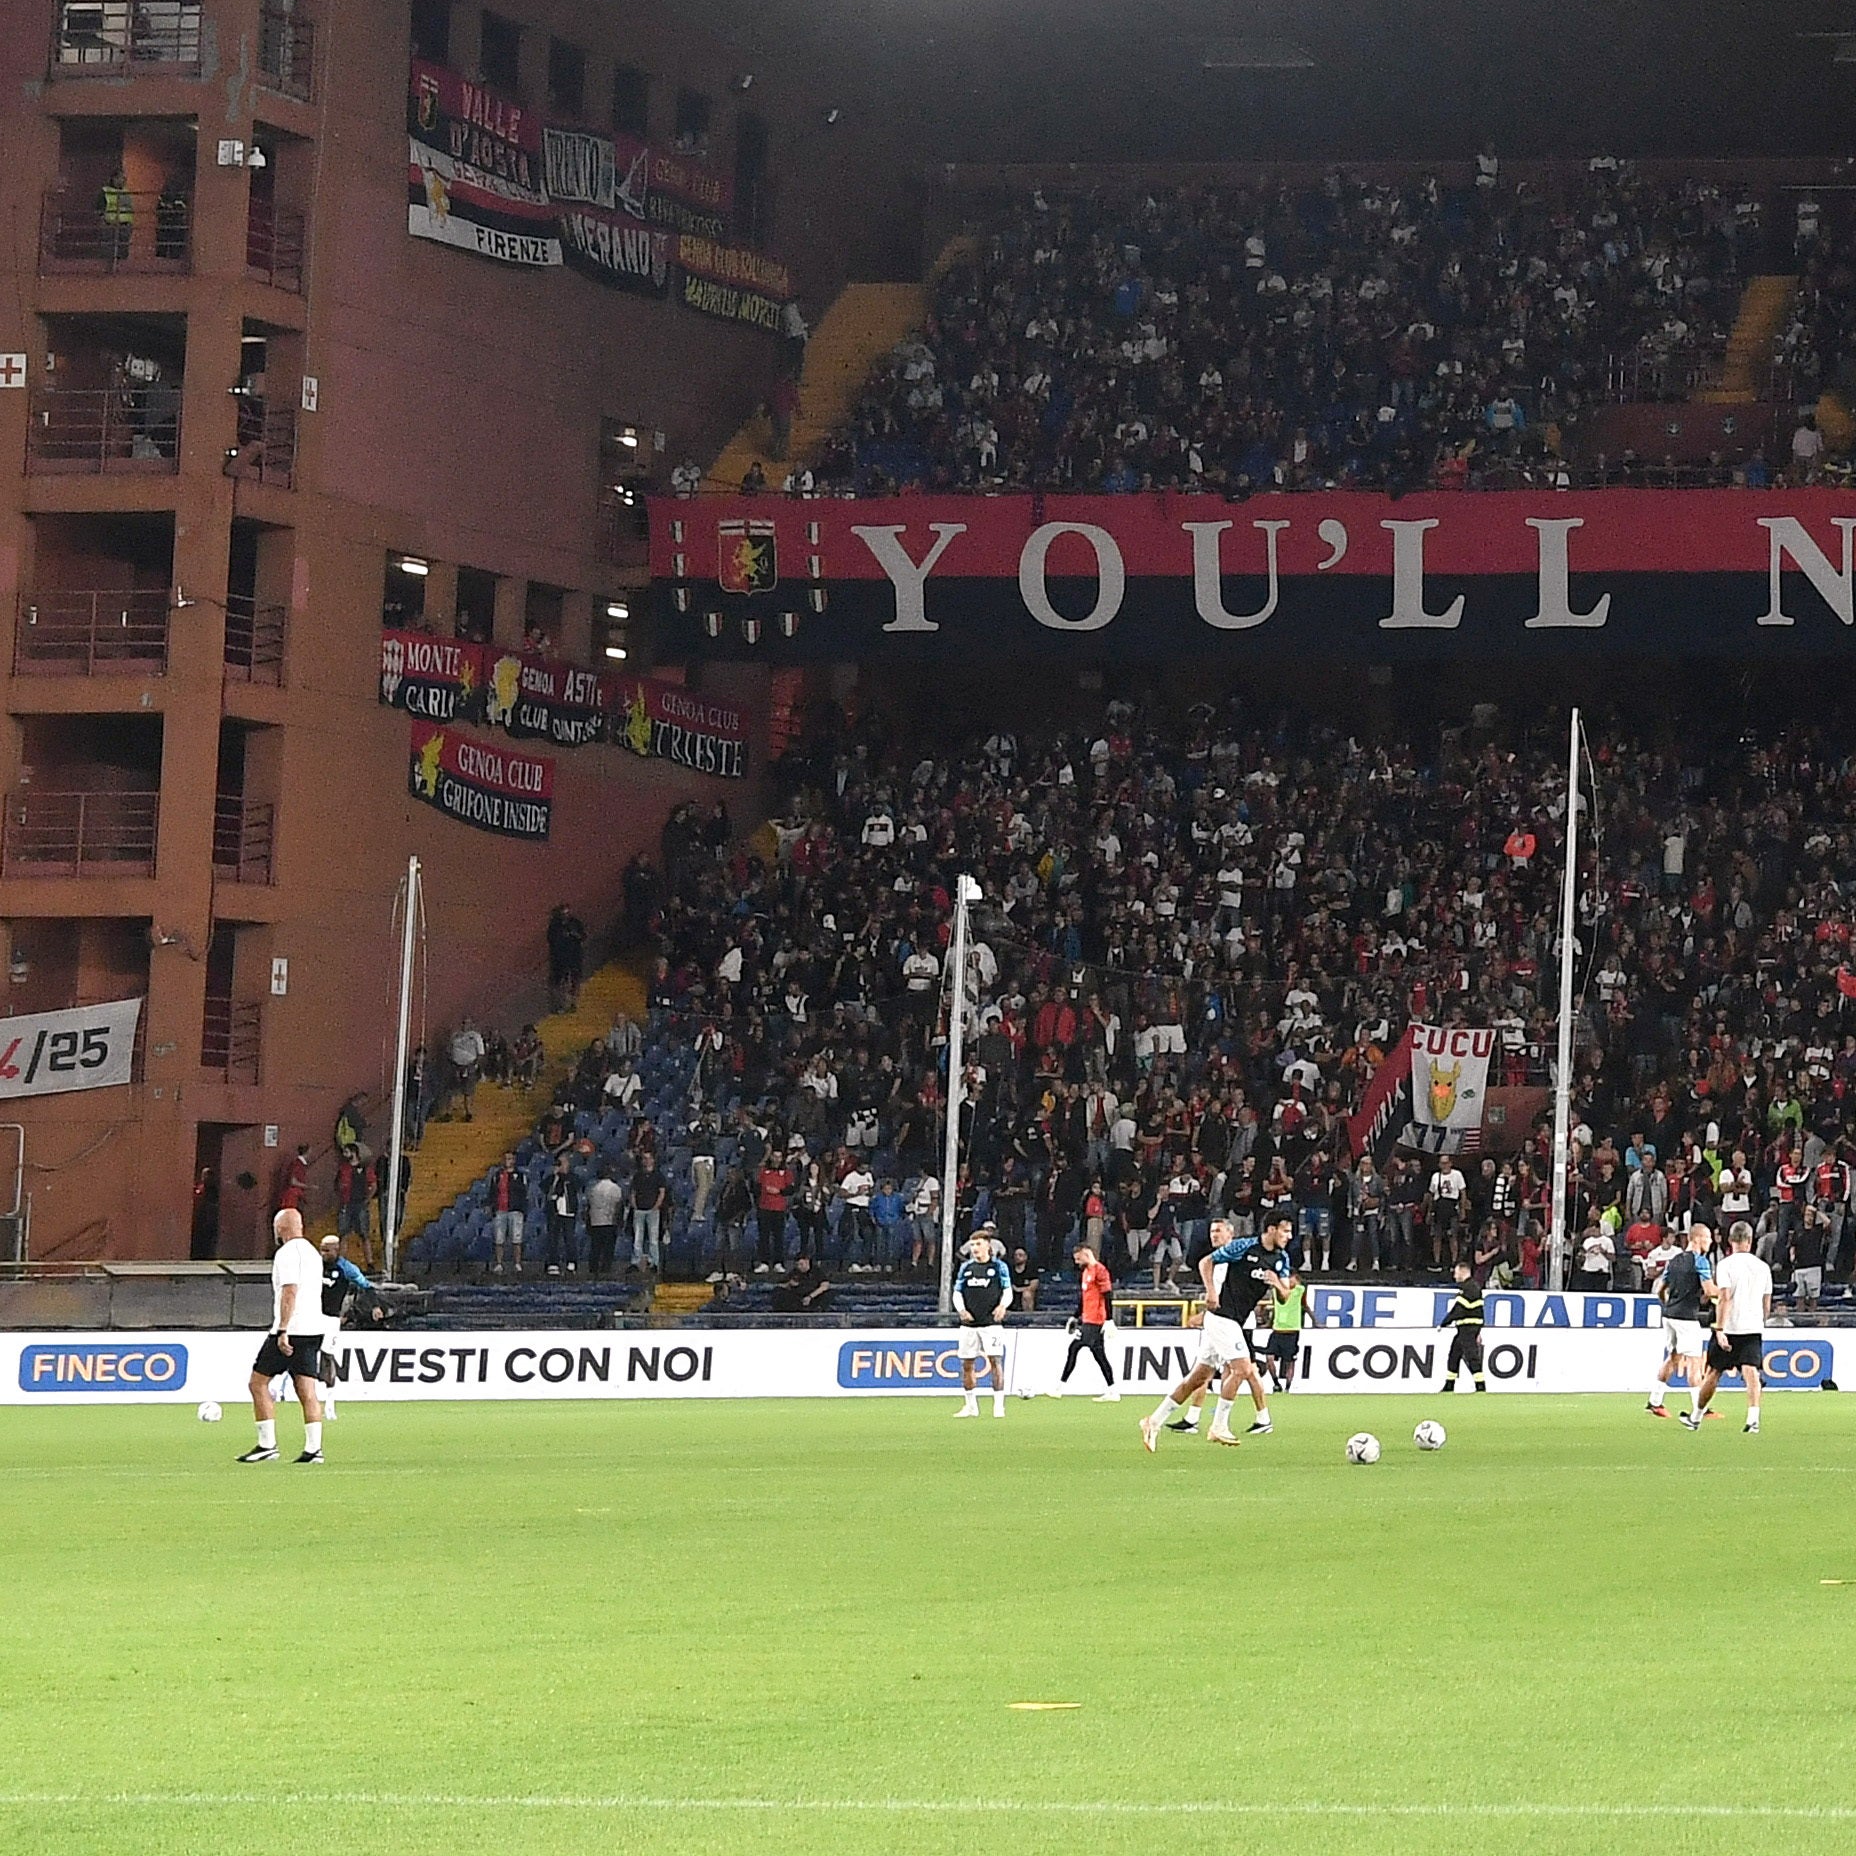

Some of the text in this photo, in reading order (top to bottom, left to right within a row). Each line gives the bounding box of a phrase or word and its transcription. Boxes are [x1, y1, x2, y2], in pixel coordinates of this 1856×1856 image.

[462, 81, 521, 144] VALLE
[475, 227, 550, 263] FIRENZE
[571, 213, 650, 277] MERANO
[851, 517, 1611, 633] YOU'LL
[407, 642, 461, 676] MONTE
[522, 666, 554, 697] GENOA
[520, 703, 549, 731] CLUB
[661, 694, 740, 731] GENOA CLUB
[655, 719, 742, 777] TRIESTE
[458, 744, 543, 792] GENOA CLUB
[443, 779, 548, 833] GRIFONE INSIDE
[1409, 1024, 1493, 1058] CUCU
[967, 1276, 991, 1289] ebay
[32, 1353, 176, 1382] FINECO
[322, 1346, 713, 1383] NVESTI CON NOI
[1122, 1345, 1312, 1381] INVI
[1328, 1344, 1434, 1379] CON
